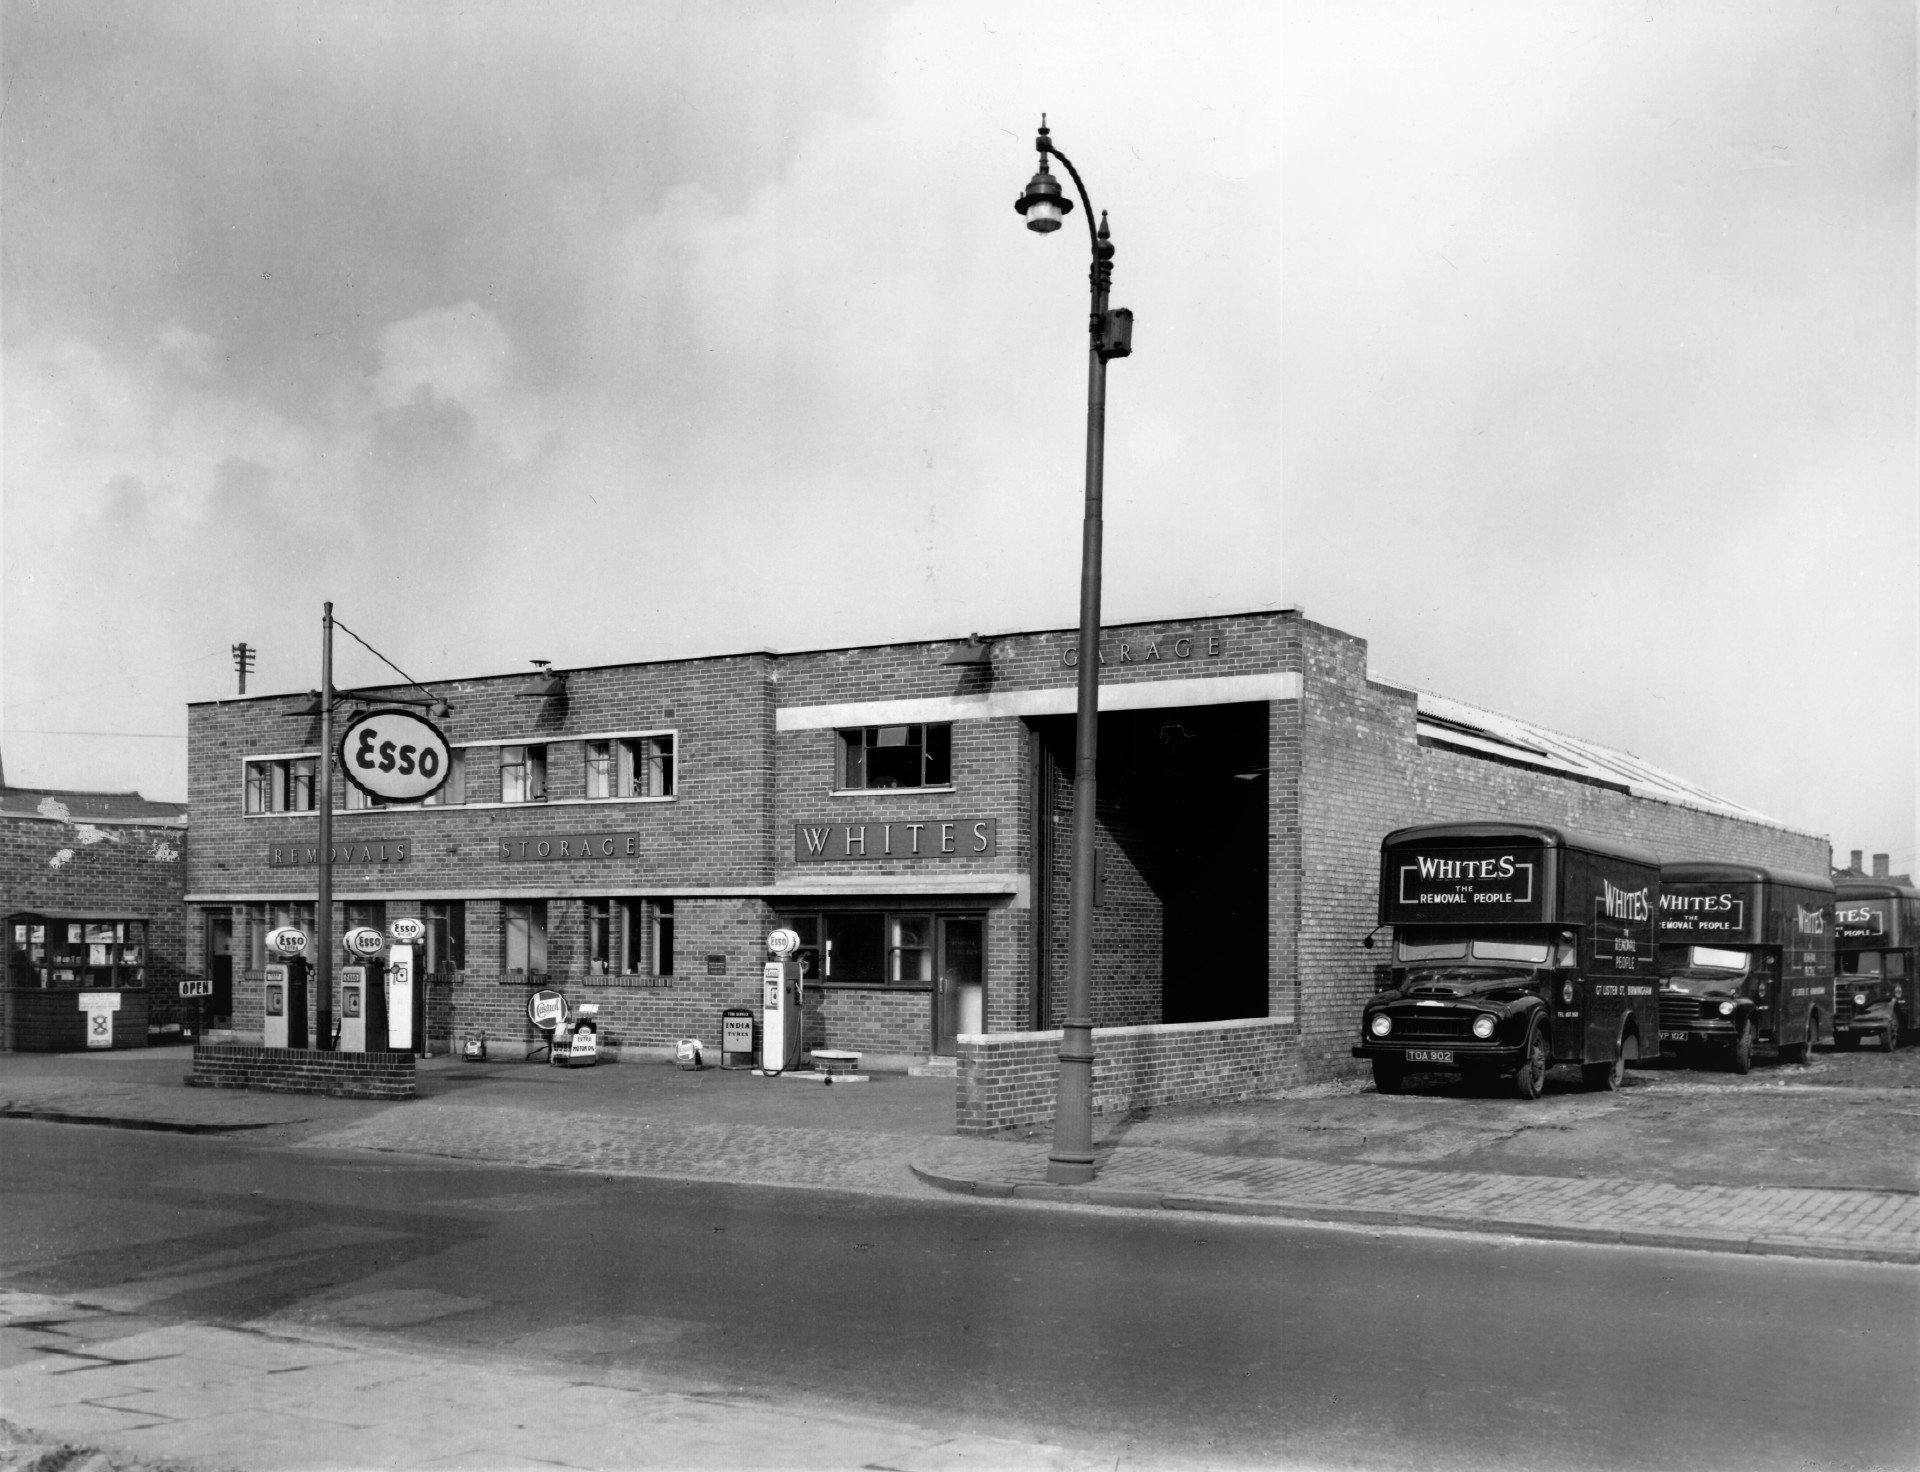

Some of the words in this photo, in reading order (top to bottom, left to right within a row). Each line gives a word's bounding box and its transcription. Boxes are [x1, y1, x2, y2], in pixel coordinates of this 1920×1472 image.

[803, 822, 988, 856] WHITES
[502, 838, 636, 858] STORAGE
[1417, 856, 1514, 879] WHITES
[1420, 894, 1466, 903] REMOVAL
[1474, 893, 1512, 903] PEOPLE
[1604, 878, 1649, 922] WHITES
[1835, 907, 1871, 922] TES
[1660, 921, 1694, 930] EMOVAL
[1699, 921, 1730, 930] PEOPLE
[1843, 929, 1870, 937] PEOPLE
[1615, 956, 1635, 969] PEOPLE
[183, 981, 209, 995] OPEN
[1660, 1032, 1670, 1040] VP
[1408, 1051, 1428, 1061] TOA
[1430, 1051, 1451, 1061] 902
